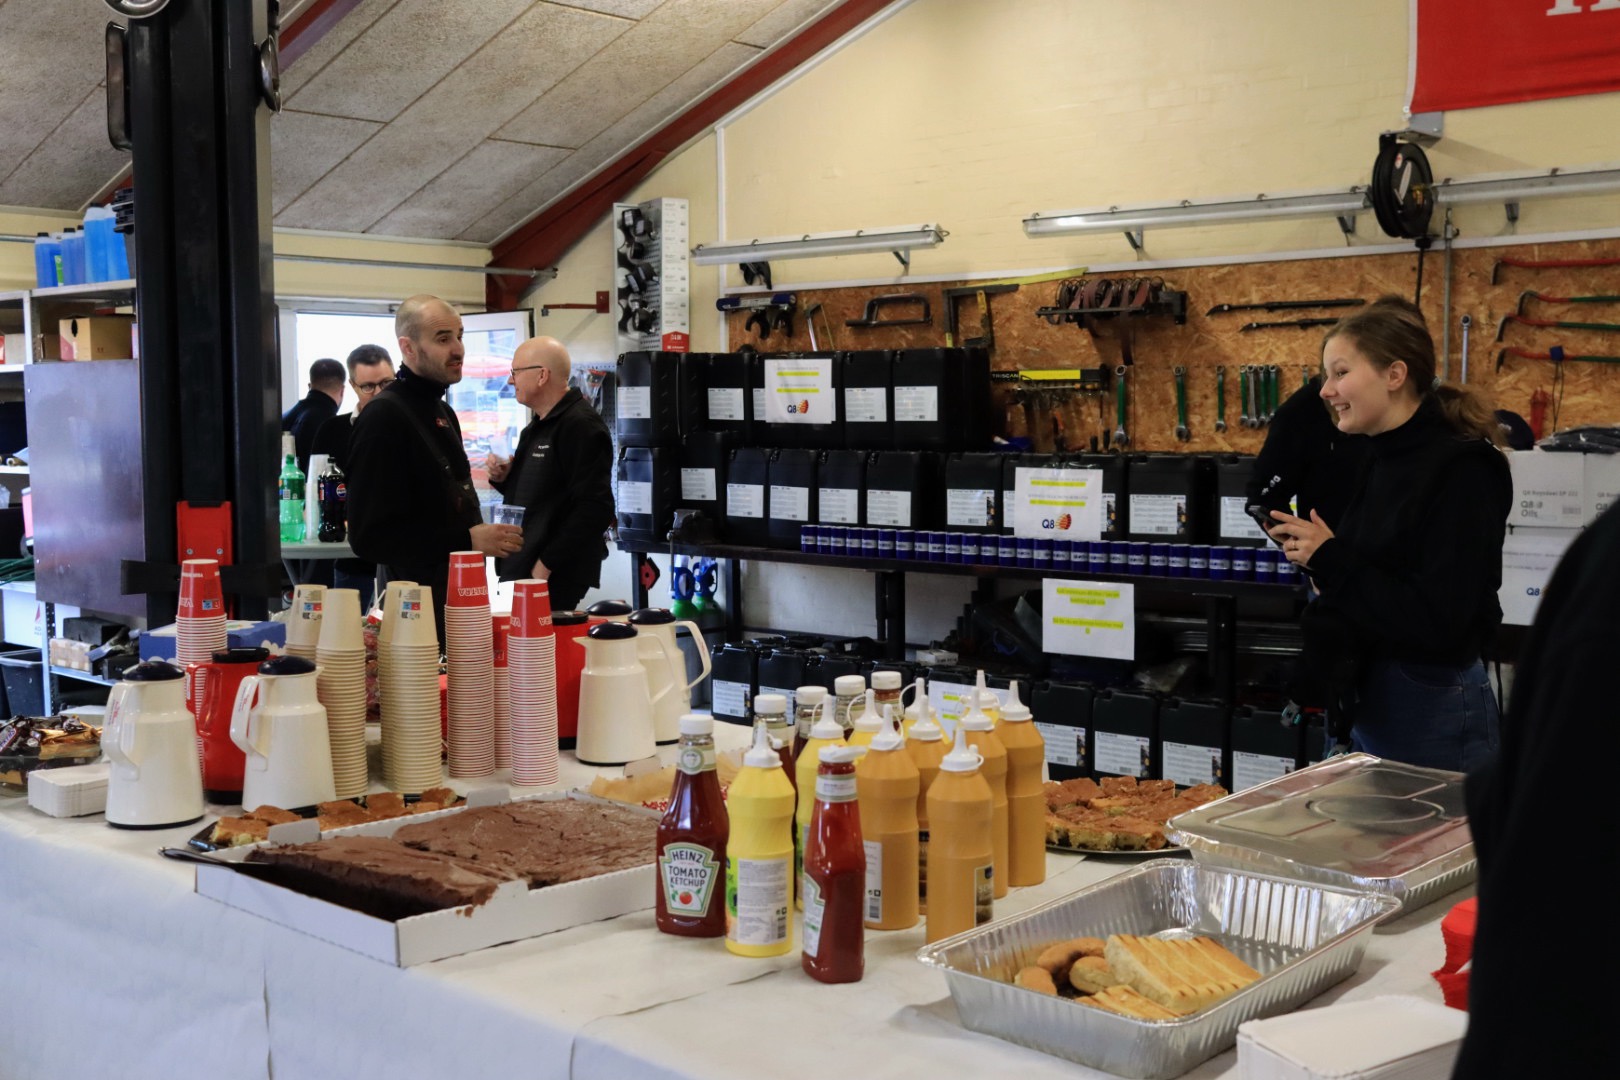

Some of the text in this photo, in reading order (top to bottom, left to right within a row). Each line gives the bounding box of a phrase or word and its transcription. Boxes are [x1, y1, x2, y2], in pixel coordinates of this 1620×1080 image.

[787, 404, 797, 413] Q8
[1521, 500, 1533, 509] Q8
[1042, 519, 1055, 529] Q8
[1526, 587, 1540, 596] Q8
[672, 850, 704, 863] HEINZ
[668, 865, 707, 879] TOMATO
[670, 877, 706, 887] KETCHUP
